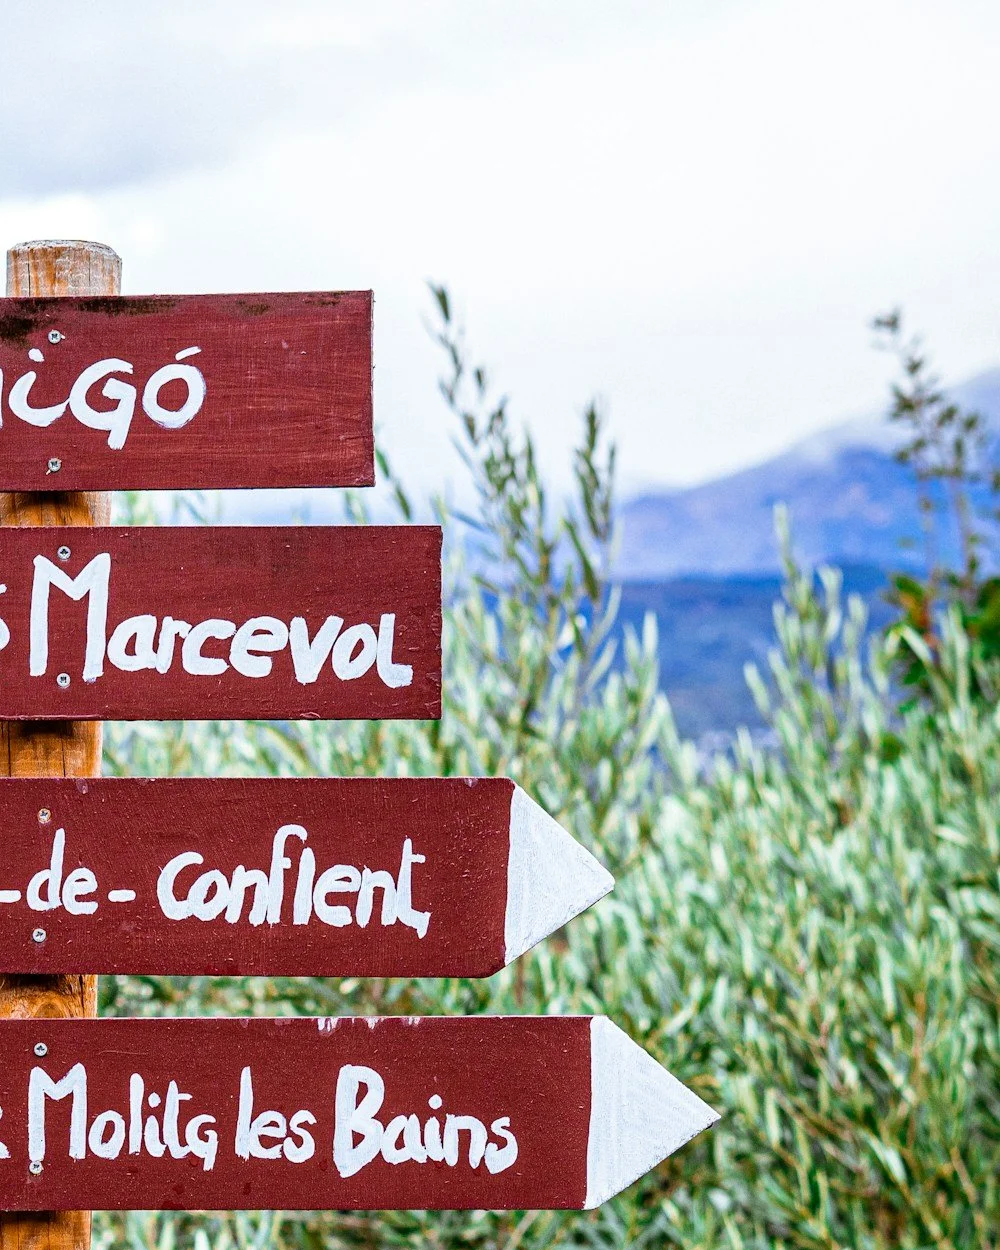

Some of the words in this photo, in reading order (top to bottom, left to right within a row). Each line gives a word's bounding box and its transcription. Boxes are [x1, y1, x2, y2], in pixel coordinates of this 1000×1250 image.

[30, 552, 414, 689] Marcevol
[28, 1062, 219, 1172] Molitg
[235, 1066, 317, 1164] les
[333, 1063, 519, 1179] Bains
